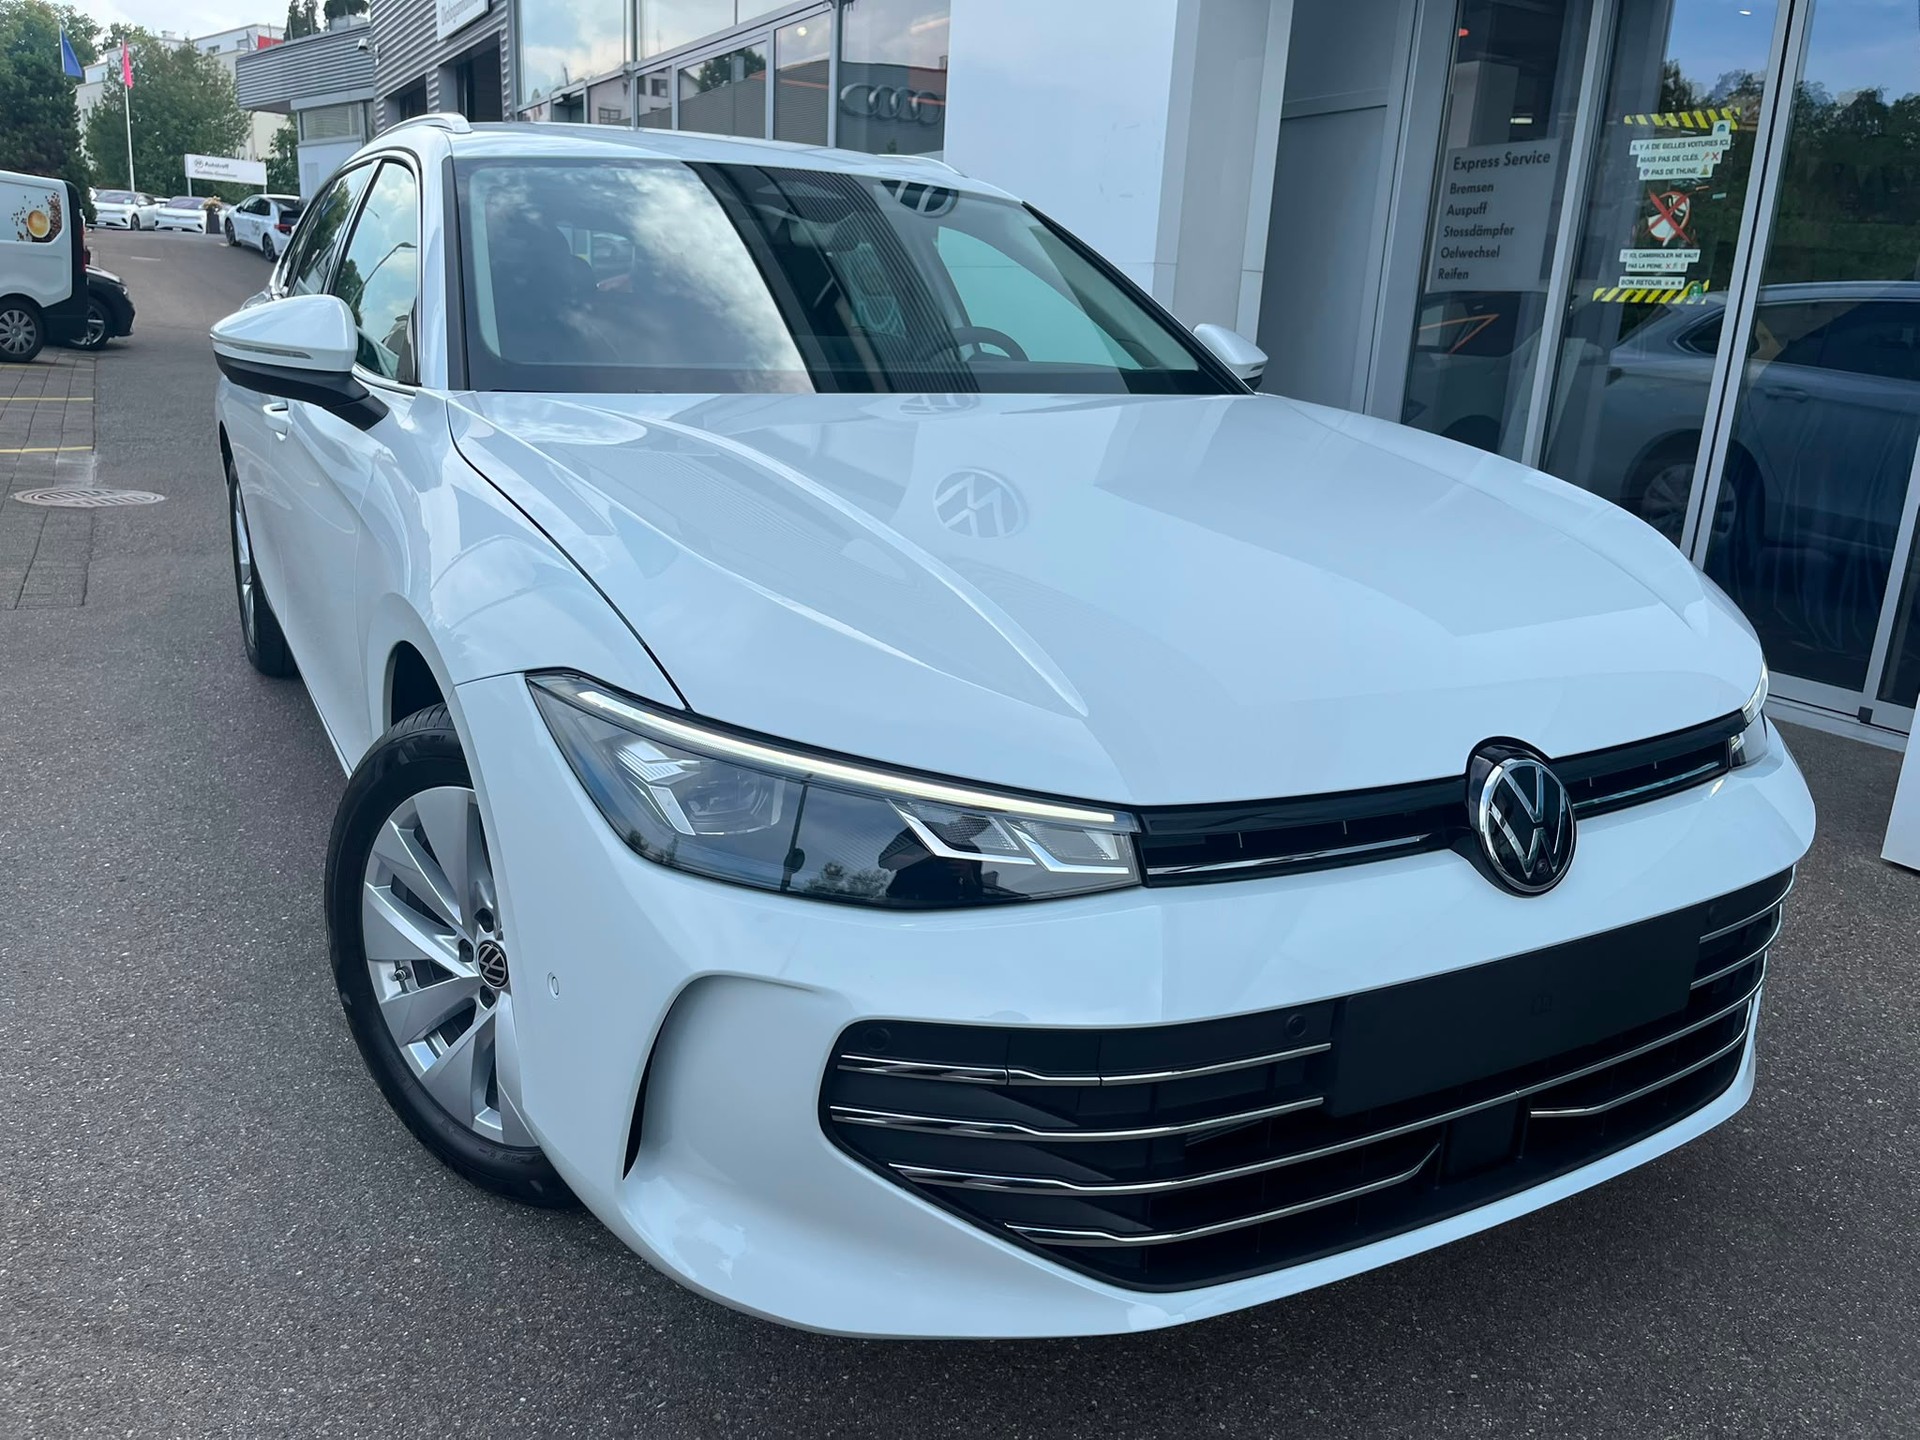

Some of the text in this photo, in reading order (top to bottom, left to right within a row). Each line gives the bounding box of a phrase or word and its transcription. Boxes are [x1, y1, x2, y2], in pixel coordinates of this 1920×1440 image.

[1651, 142, 1661, 150] DE
[1662, 141, 1687, 150] BELLES
[1687, 140, 1718, 148] VOITURES
[1453, 150, 1551, 173] Express Service
[1640, 155, 1656, 163] MAIS
[1671, 154, 1681, 162] DE
[1650, 168, 1665, 176] PAS
[1449, 182, 1495, 195] Bremsen
[1446, 202, 1488, 218] Auspuff
[1443, 223, 1515, 239] Stossdämpfer
[1440, 244, 1501, 259] Oelwechsel
[1437, 267, 1469, 280] Reifen
